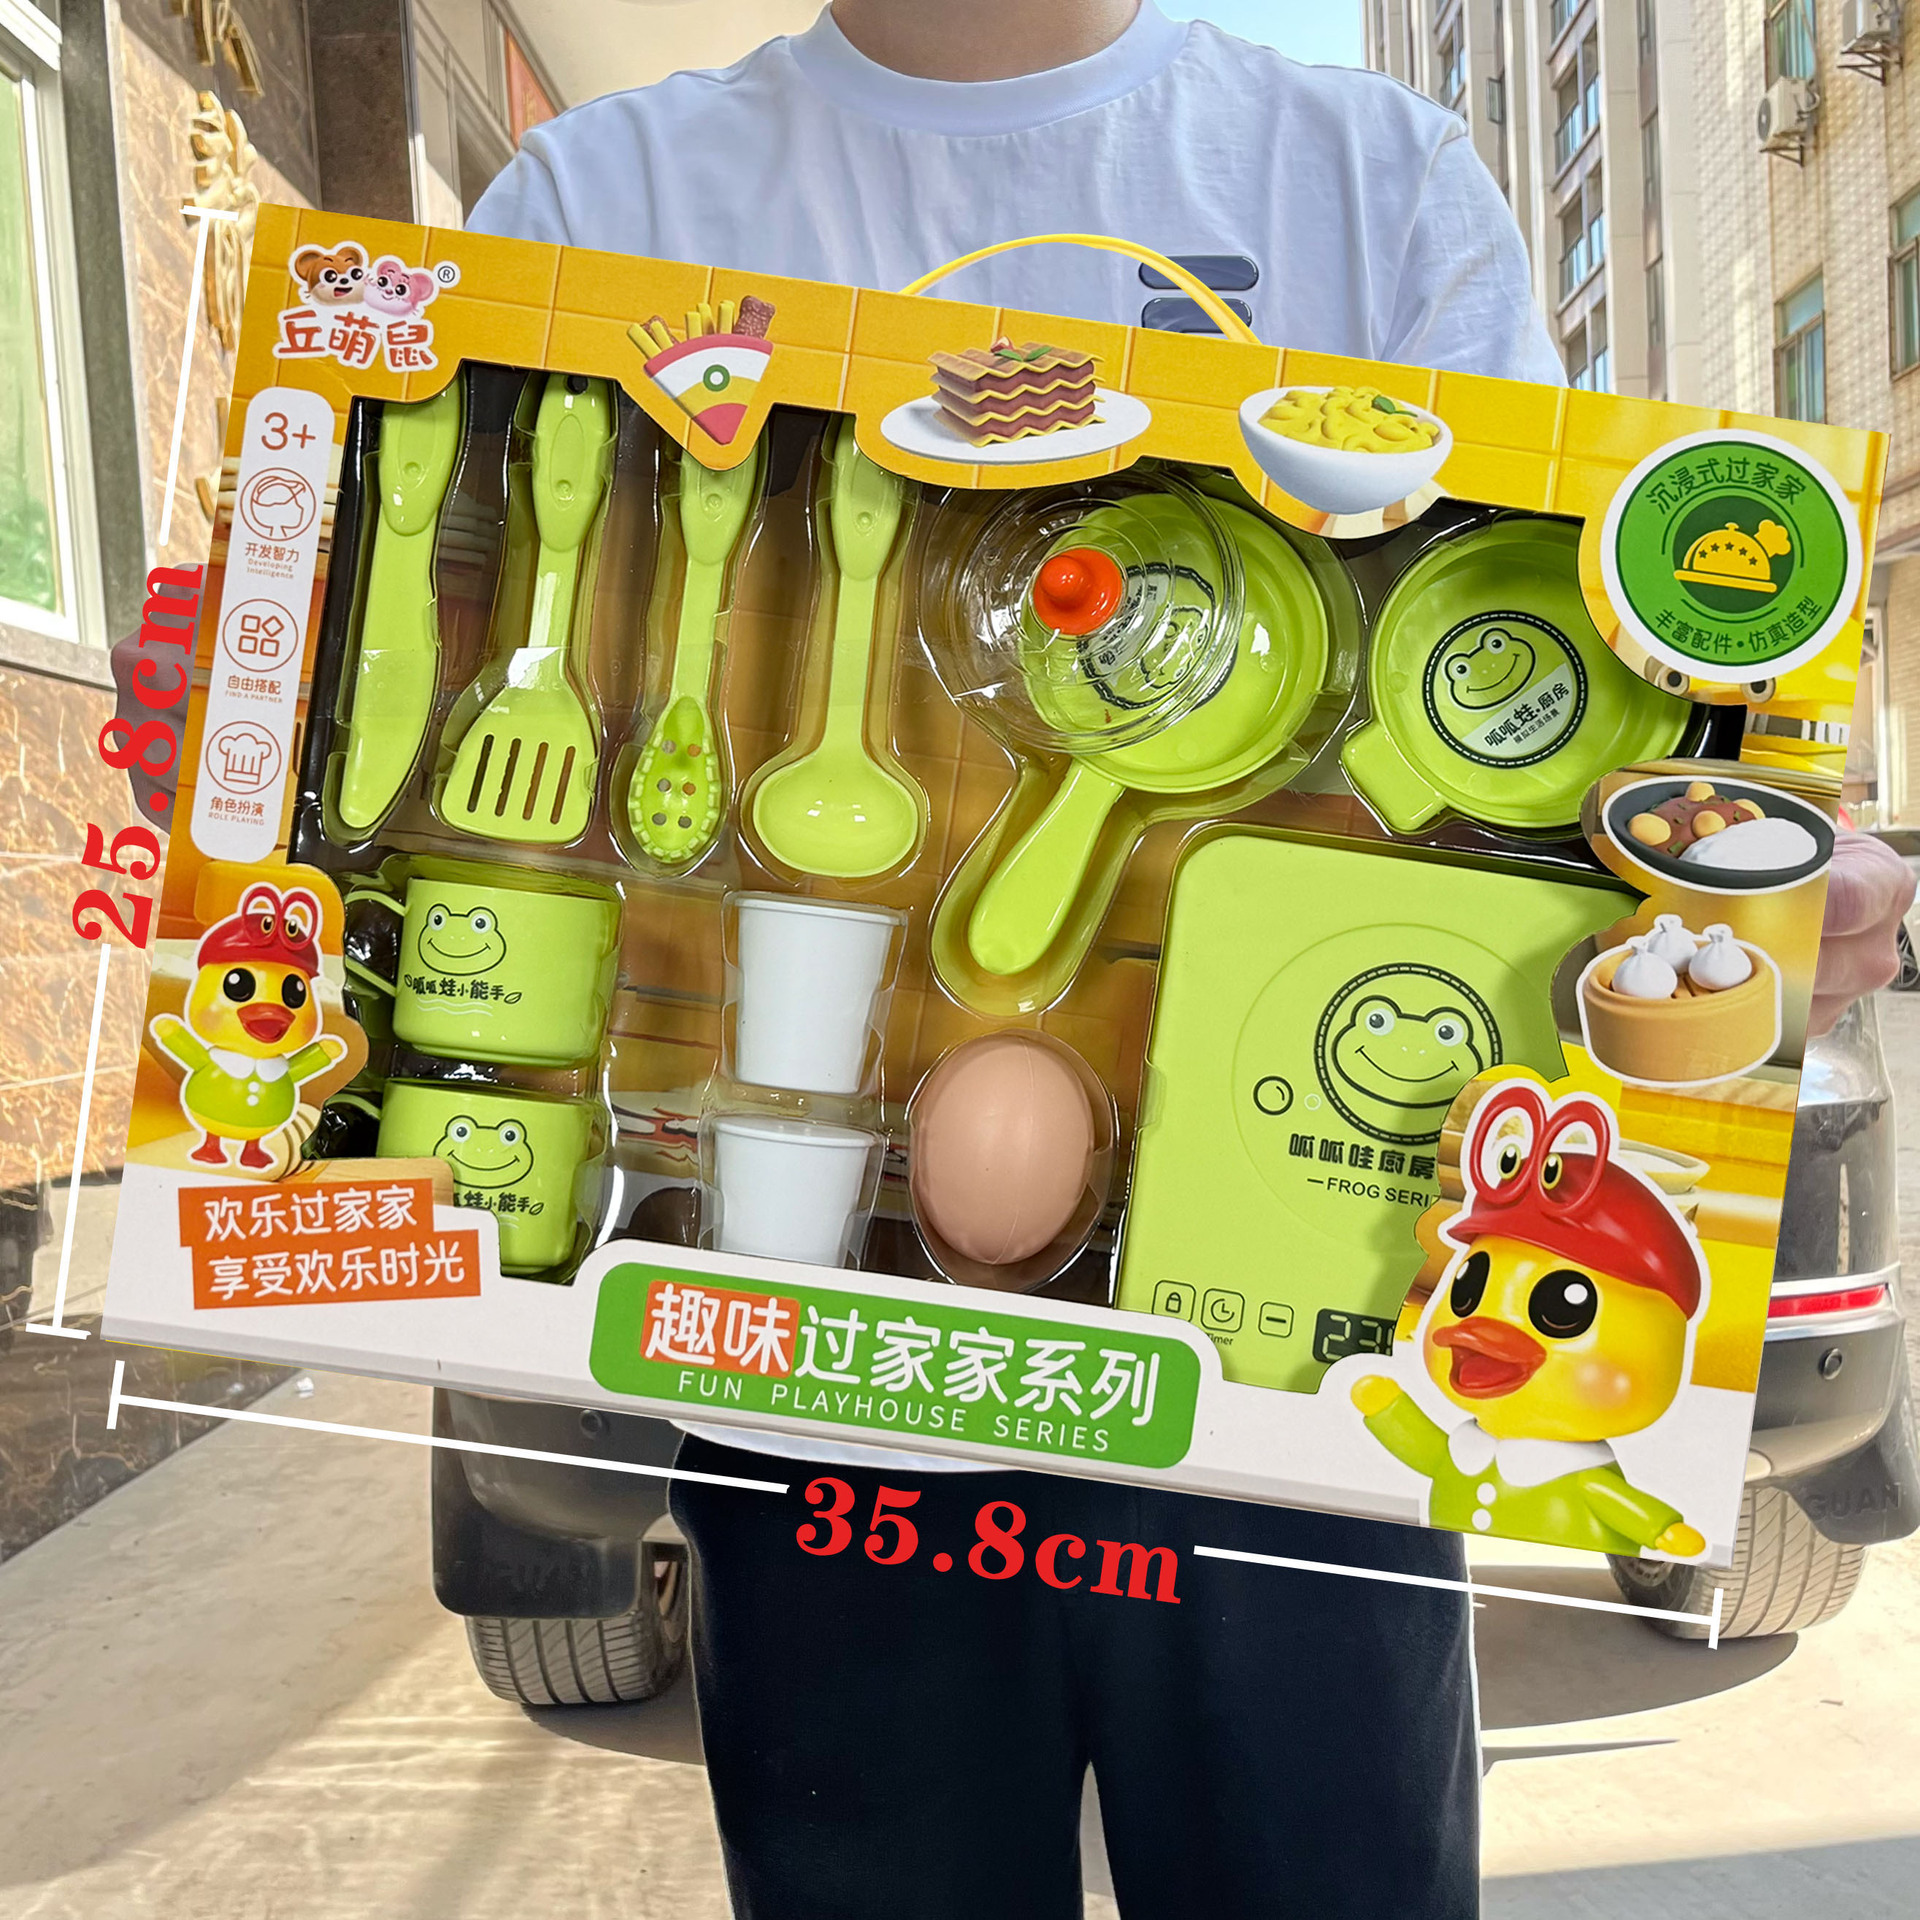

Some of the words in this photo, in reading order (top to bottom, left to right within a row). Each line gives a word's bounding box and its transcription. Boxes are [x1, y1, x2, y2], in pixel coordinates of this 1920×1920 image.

[278, 309, 433, 368] 丘萌鼠
[261, 411, 316, 450] 3+
[1646, 457, 1806, 515] 沉浸式过家家
[245, 542, 299, 563] 开发智力
[248, 558, 293, 572] Developing
[247, 567, 294, 579] Intelligence
[225, 690, 242, 698] FIND
[251, 694, 283, 703] PARTNER
[227, 675, 281, 695] 自由搭配
[208, 812, 228, 821] ROLE
[230, 815, 265, 826] PLAYING
[210, 796, 265, 817] 角色扮演
[412, 976, 505, 1001] 呱呱蛙小能手
[204, 1184, 417, 1242] 欢乐过家家
[209, 1240, 465, 1301] 享受欢乐时光
[646, 1288, 1160, 1427] 趣味过家家系列
[678, 1370, 742, 1400] FUN
[771, 1384, 966, 1432] PLAYHOUSE
[993, 1414, 1109, 1452] SERIES
